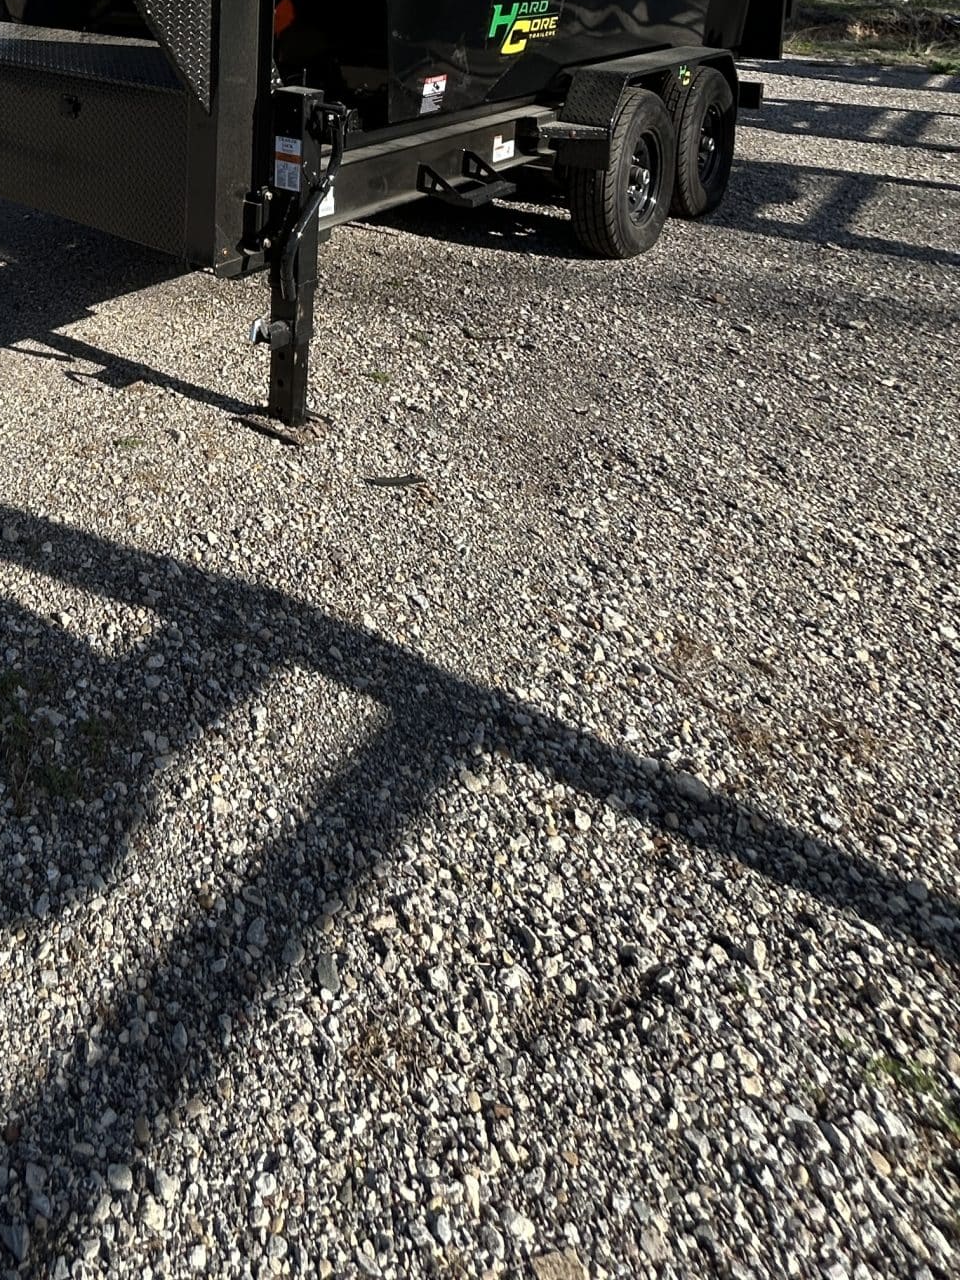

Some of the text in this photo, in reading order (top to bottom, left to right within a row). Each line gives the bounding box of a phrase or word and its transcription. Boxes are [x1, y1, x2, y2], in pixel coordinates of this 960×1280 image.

[488, 0, 549, 44] HARD
[501, 16, 559, 55] CORE
[529, 30, 556, 39] TRAILERS
